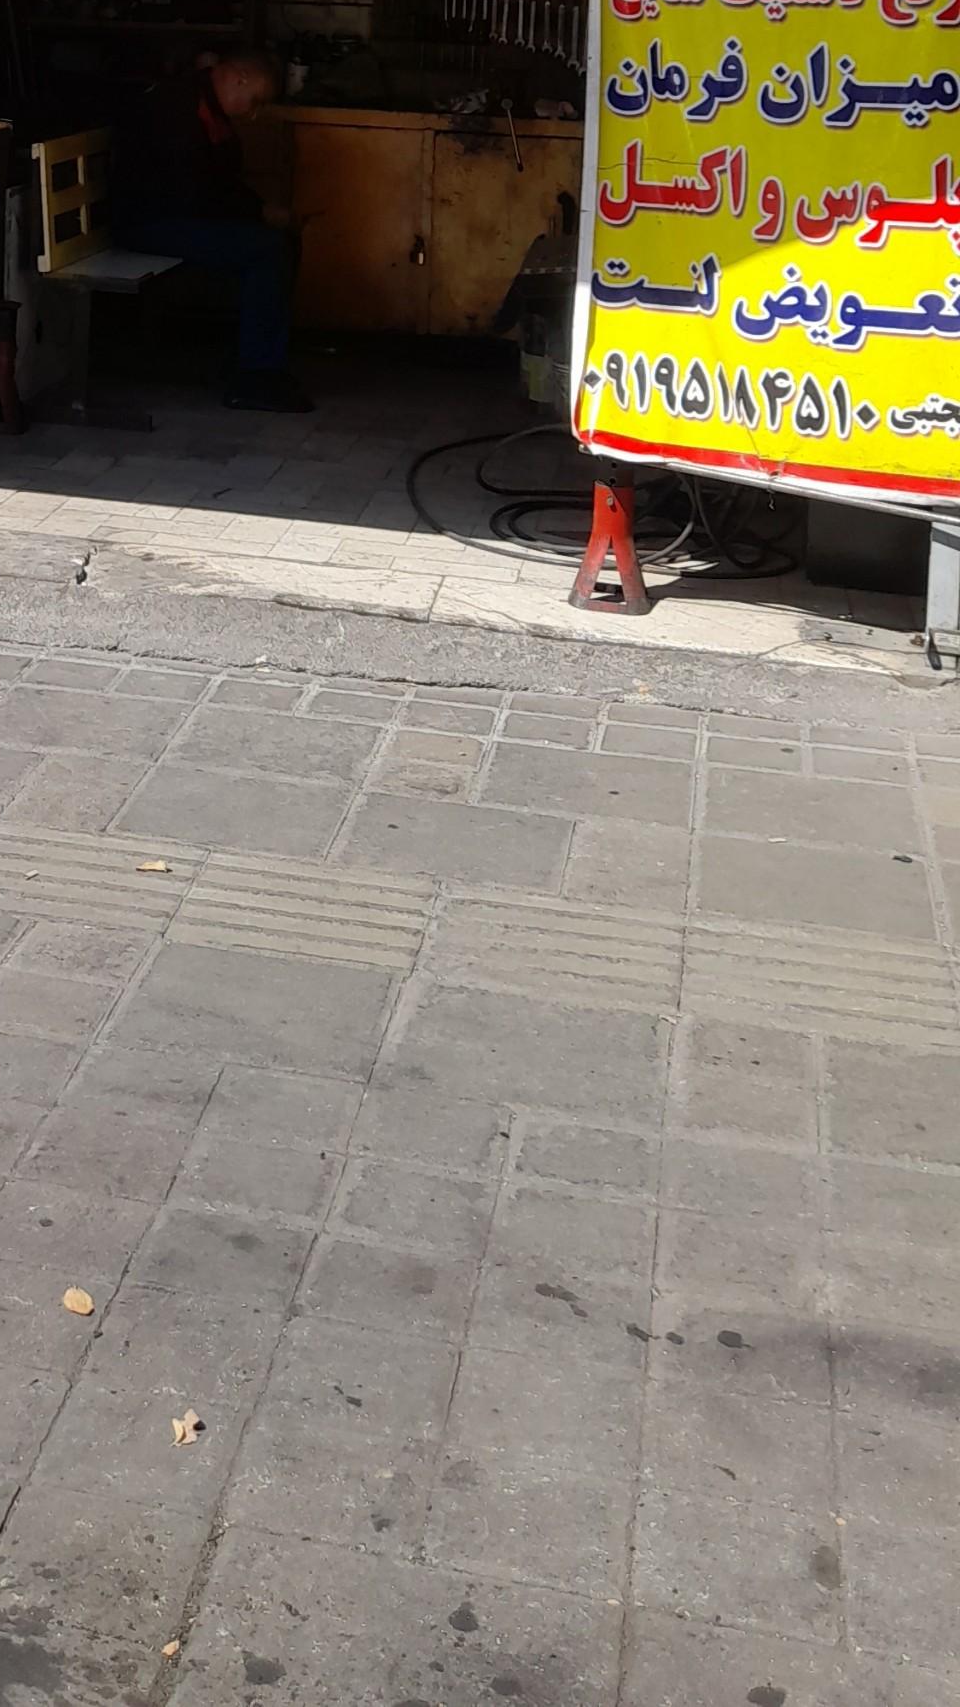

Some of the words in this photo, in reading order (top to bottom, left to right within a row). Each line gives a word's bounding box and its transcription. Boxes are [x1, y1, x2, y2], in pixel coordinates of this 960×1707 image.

[607, 36, 748, 121] فرمان
[759, 42, 960, 127] میزان
[597, 139, 748, 226] اکسل
[753, 175, 785, 240] و
[590, 254, 722, 314] لنت
[582, 351, 880, 439] ۰۹۱۹۵۱۸۴۵۱۰
[887, 393, 960, 438] جتبی
